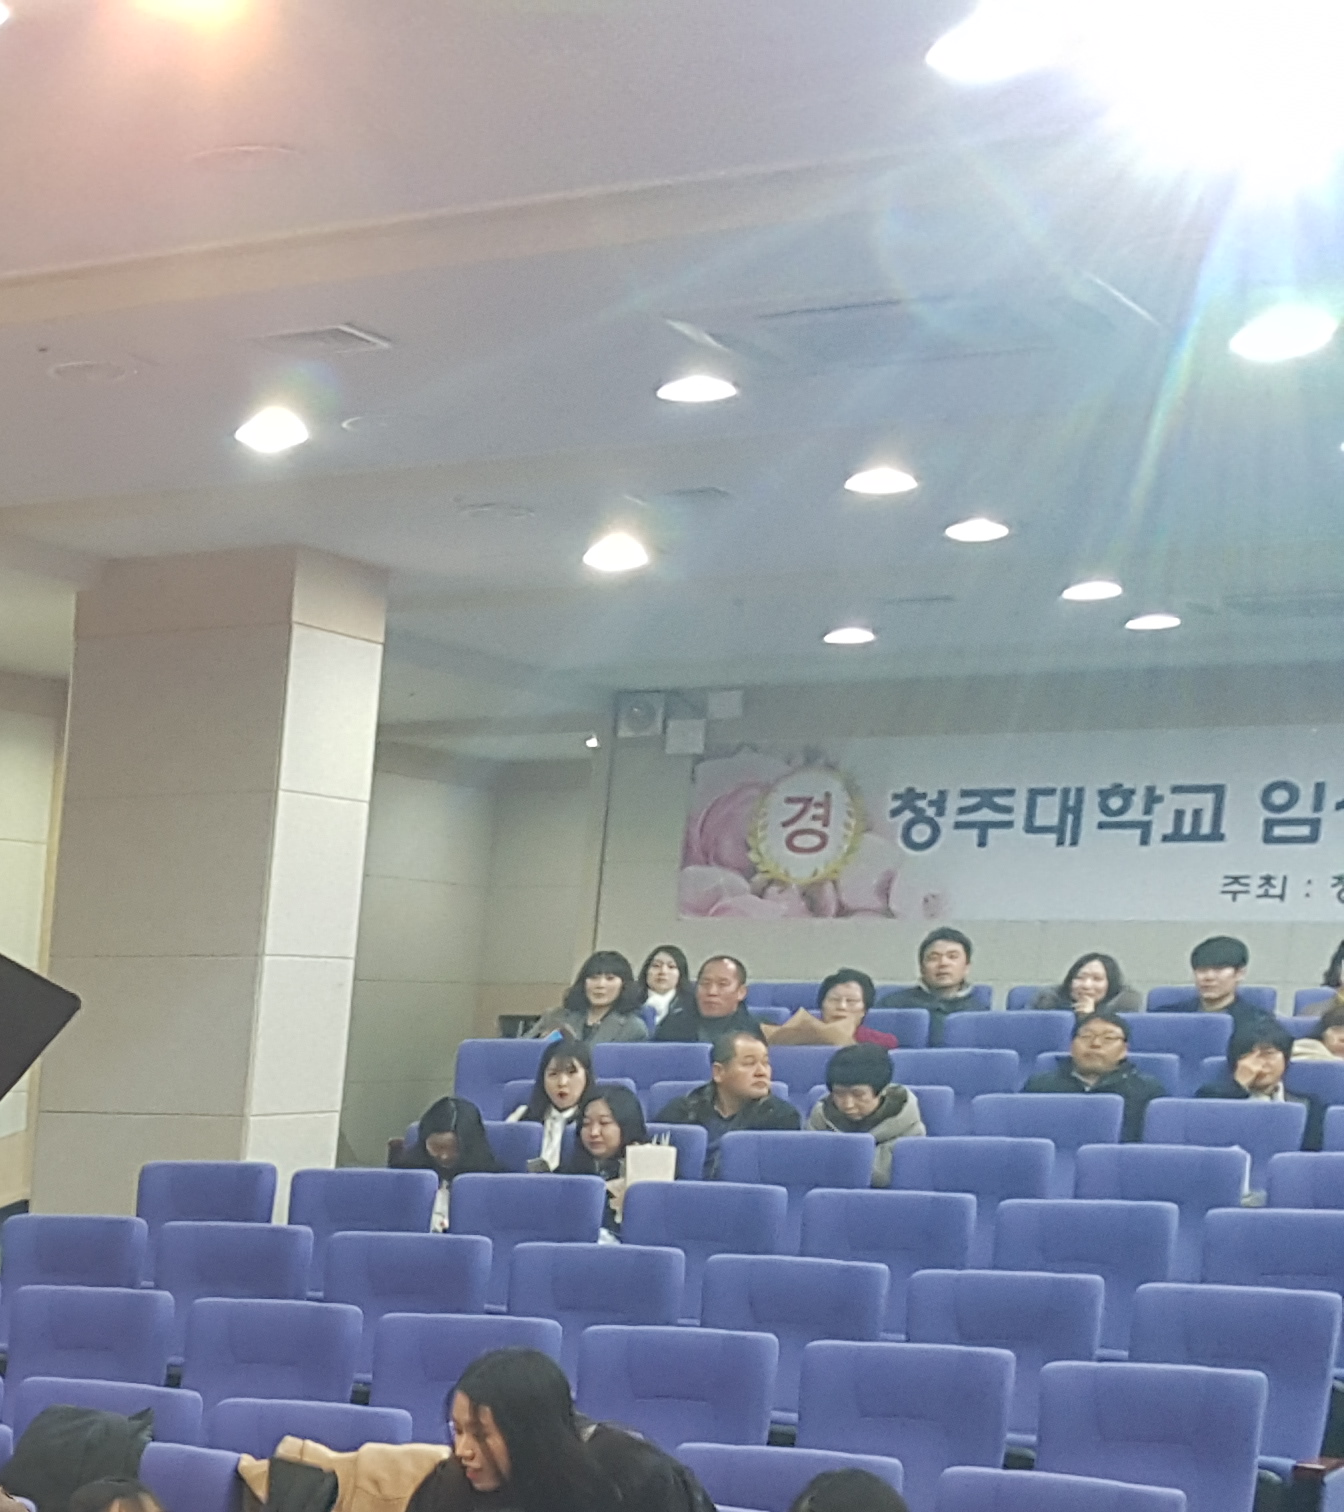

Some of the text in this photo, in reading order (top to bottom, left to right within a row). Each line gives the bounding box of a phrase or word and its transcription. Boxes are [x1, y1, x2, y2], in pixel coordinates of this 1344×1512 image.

[781, 780, 1344, 855] 경 청주대학교 임
[1220, 874, 1288, 903] 주최
